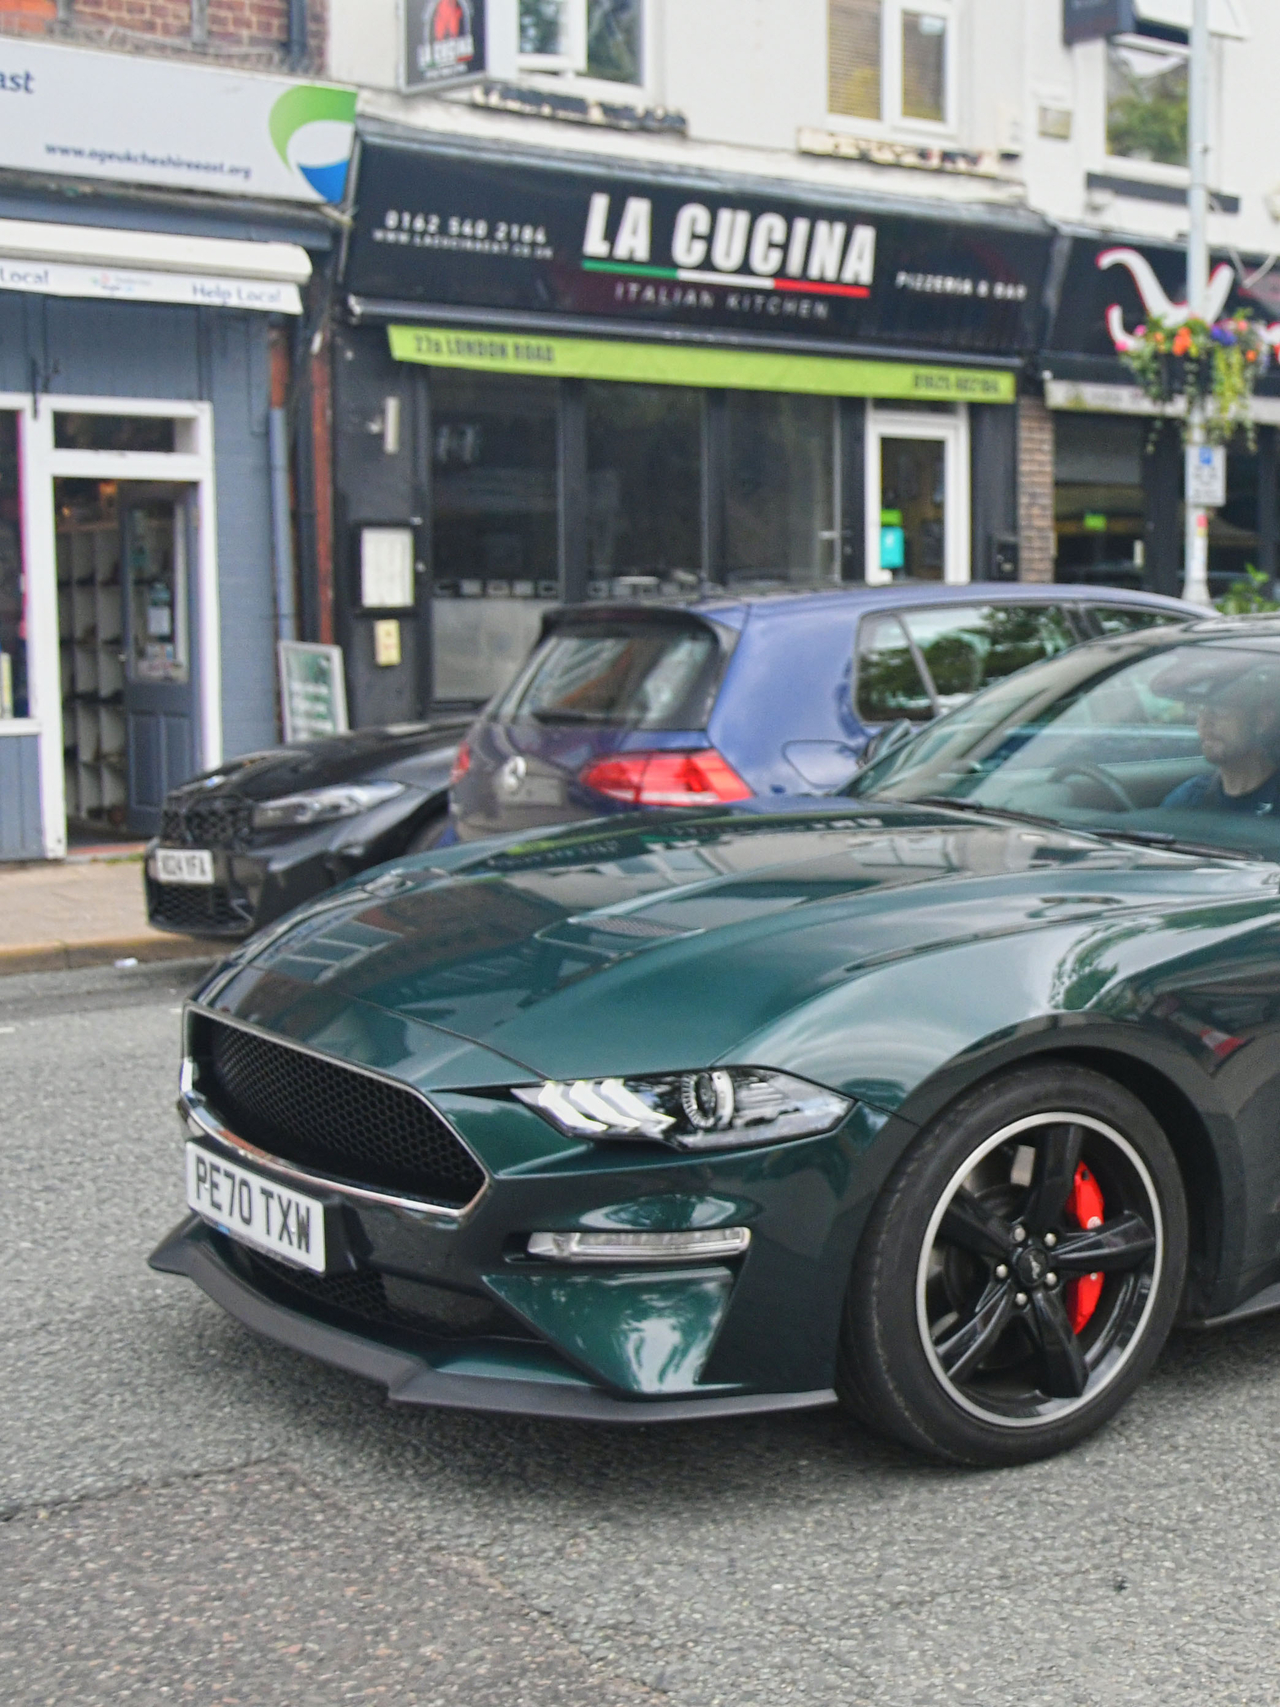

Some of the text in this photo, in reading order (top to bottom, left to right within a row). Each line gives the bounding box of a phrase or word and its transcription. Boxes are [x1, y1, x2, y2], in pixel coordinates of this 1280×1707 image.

[582, 192, 876, 286] LA CUCINA
[0, 268, 49, 285] Local
[192, 283, 282, 305] Help Local
[614, 281, 829, 320] ITALIAN KITCHEN
[446, 336, 508, 358] LONDON
[196, 1154, 310, 1255] PE70 TXW
